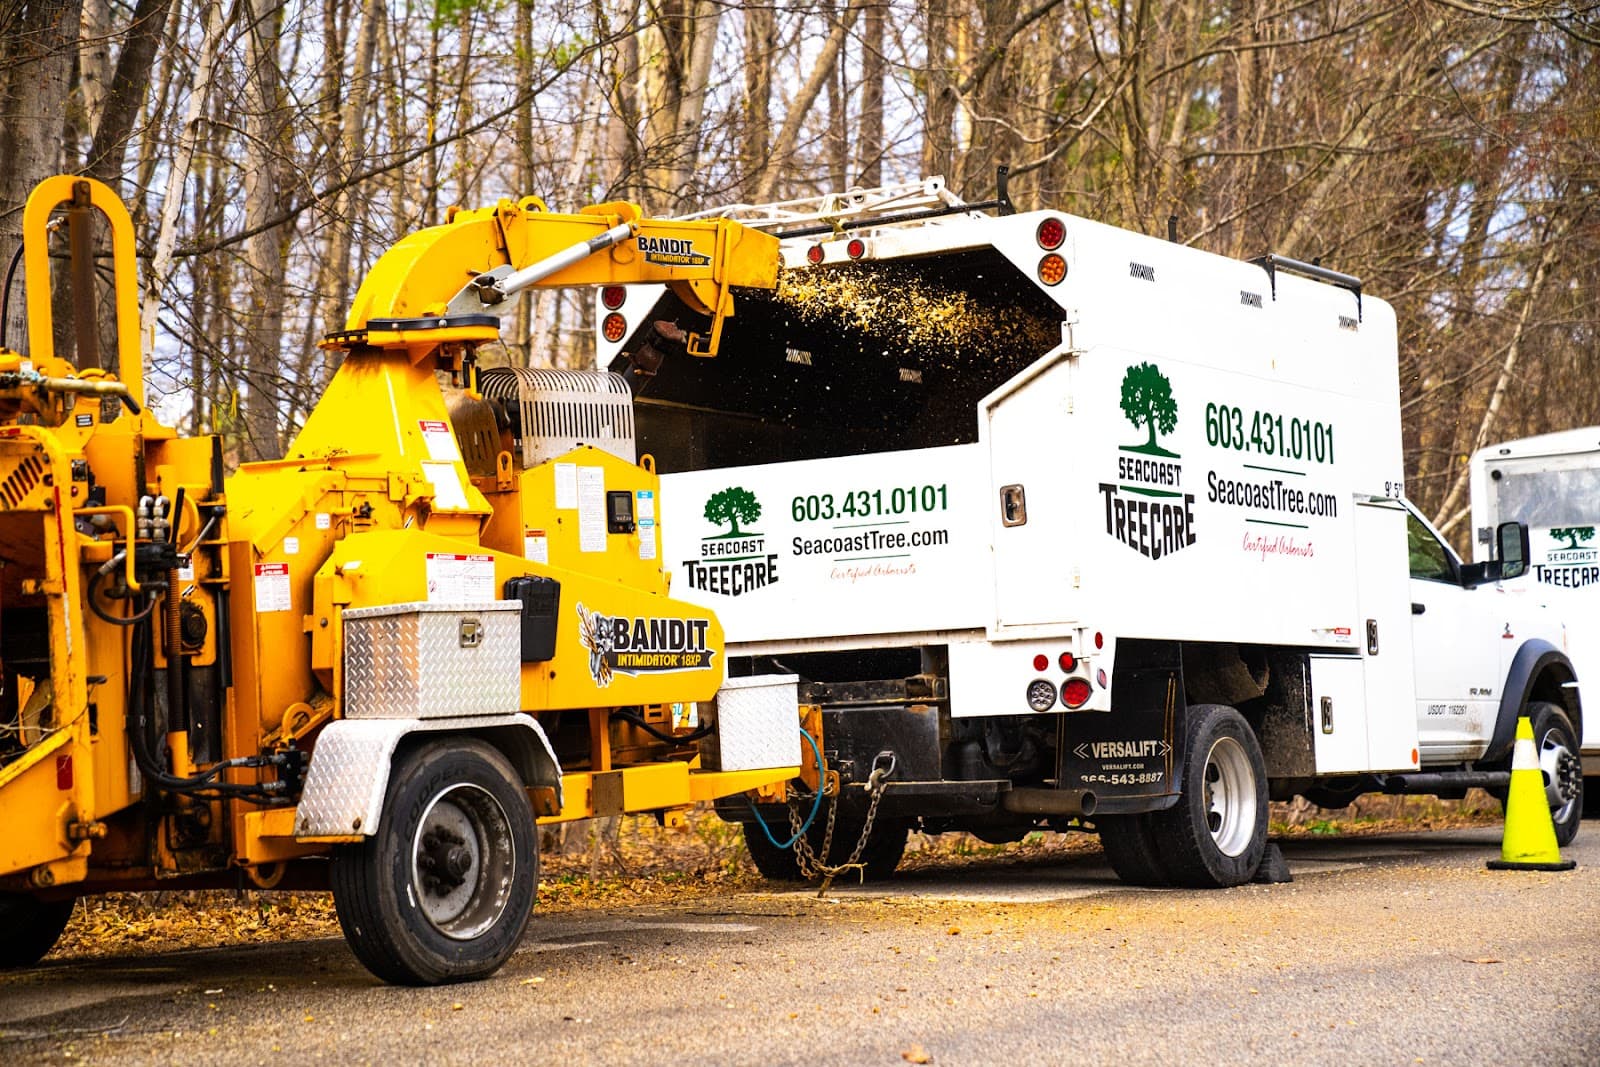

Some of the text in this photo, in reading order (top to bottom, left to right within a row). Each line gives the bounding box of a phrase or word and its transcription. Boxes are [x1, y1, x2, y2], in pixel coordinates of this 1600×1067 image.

[638, 237, 692, 255] BANDIT
[1205, 402, 1335, 465] 603.431.0101
[1118, 456, 1182, 487] SEACOAST
[791, 483, 949, 523] 603.431.0101
[1207, 470, 1338, 518] SeacoastTree.com
[1098, 482, 1197, 561] TREECARE
[701, 539, 765, 557] SEACOAST
[792, 529, 949, 556] SeacoastTree.com
[1547, 551, 1599, 562] SEACOAST
[682, 554, 780, 597] TREECARE
[613, 618, 709, 651] BANDIT
[617, 653, 702, 667] INTIMIDATOR 18XP
[1469, 687, 1493, 696] RAM
[1091, 740, 1158, 759] VERSALIFT
